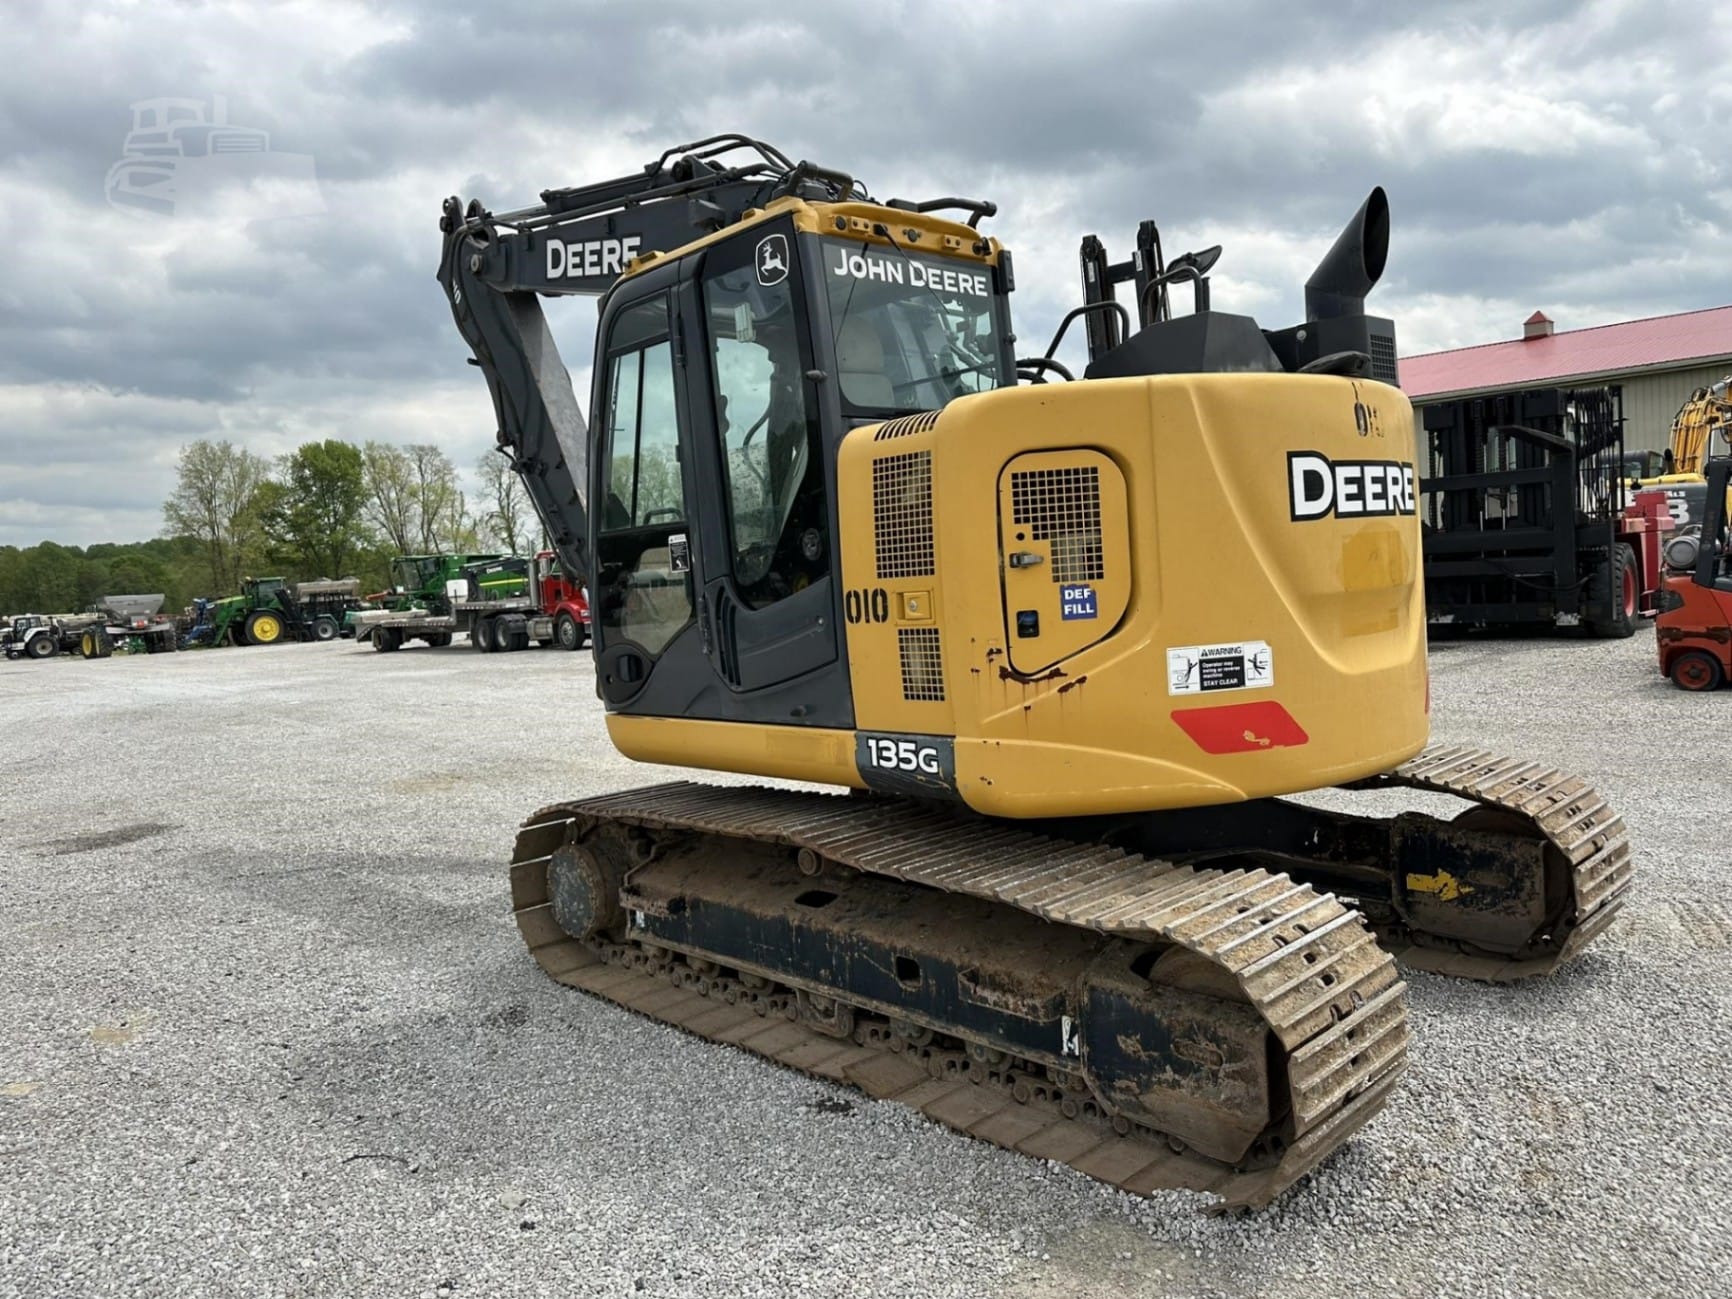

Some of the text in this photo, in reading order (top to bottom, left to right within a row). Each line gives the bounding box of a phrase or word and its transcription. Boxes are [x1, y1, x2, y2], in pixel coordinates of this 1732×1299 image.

[833, 248, 989, 298] JOHN DEERE
[1290, 454, 1416, 517] DEERE
[845, 587, 889, 624] 010
[1063, 587, 1093, 601] DEF
[1063, 603, 1096, 616] FILL
[1207, 646, 1242, 656] WARNING
[1203, 678, 1238, 687] STAY CLEAR
[867, 738, 940, 774] 135G
